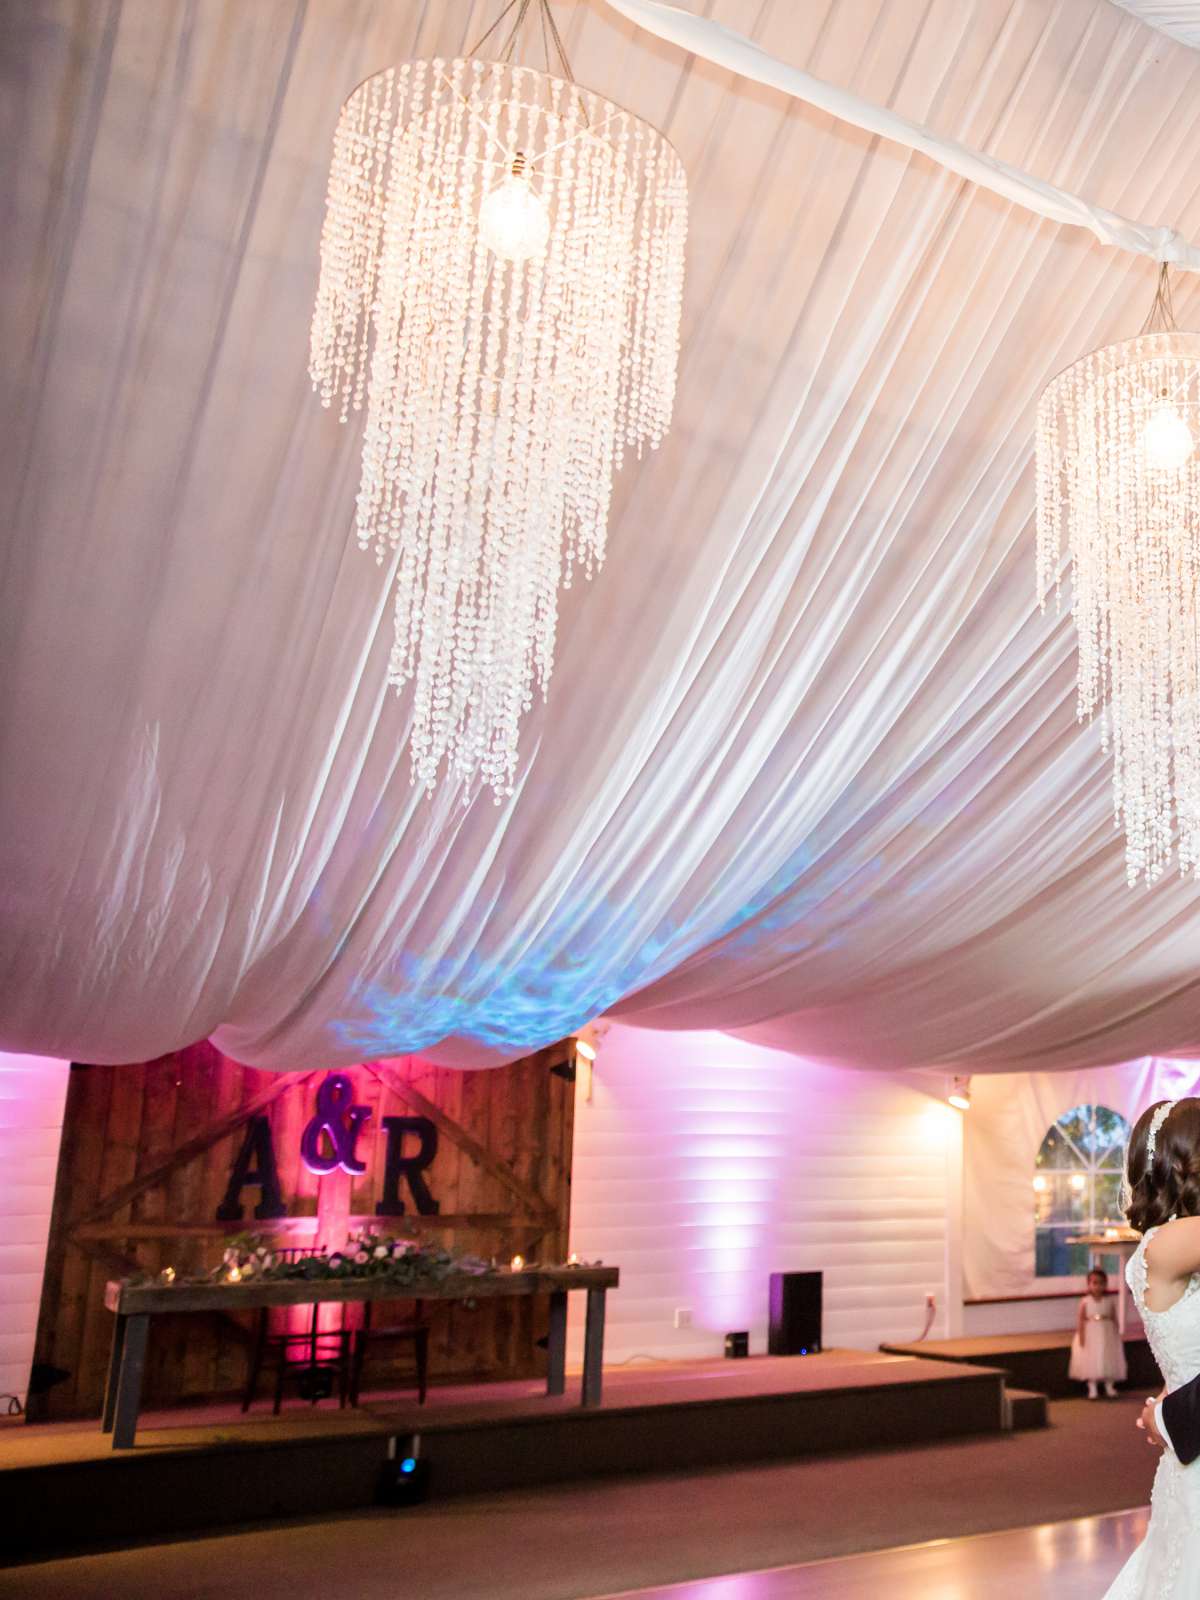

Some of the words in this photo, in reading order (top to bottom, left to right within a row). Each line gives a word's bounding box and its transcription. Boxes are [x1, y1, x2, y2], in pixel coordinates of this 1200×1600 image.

[216, 1115, 287, 1220] A
[301, 1074, 373, 1175] &
[376, 1116, 439, 1216] R
